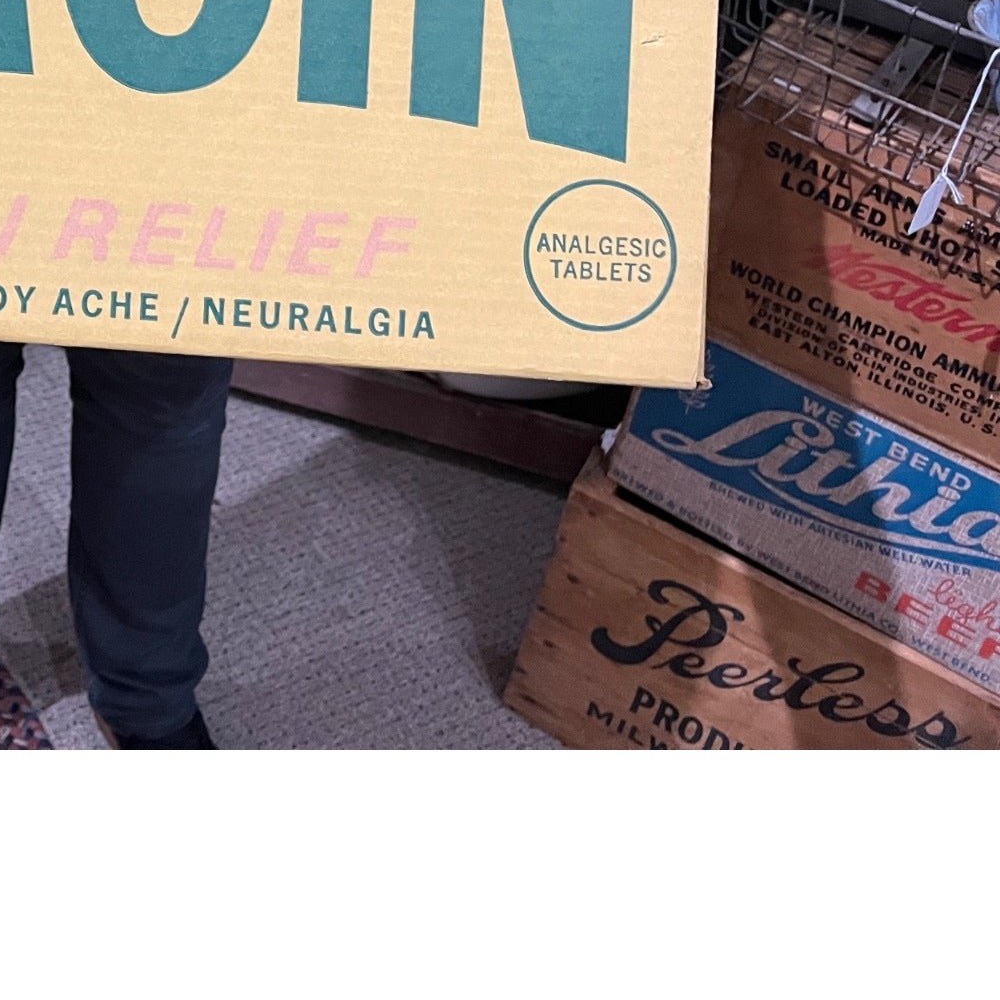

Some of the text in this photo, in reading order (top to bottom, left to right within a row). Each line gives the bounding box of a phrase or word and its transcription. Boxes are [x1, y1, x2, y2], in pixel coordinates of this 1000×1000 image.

[764, 141, 852, 190] SMALL
[780, 171, 887, 227] LOADED
[50, 195, 418, 279] RELIEF
[536, 232, 667, 260] ANALGESIC
[860, 225, 911, 257] MADE
[920, 250, 940, 267] IN
[549, 258, 653, 284] TABLETS
[51, 287, 160, 322] ACHE
[202, 295, 437, 340] NEURALGIA
[730, 259, 803, 303] WORLD
[807, 296, 928, 360] CHAMPION
[744, 288, 828, 335] WESTERN
[838, 332, 938, 384] CARTRIDGE
[748, 315, 793, 343] EAST
[757, 308, 822, 343] DIVISION
[827, 340, 848, 354] OF
[852, 351, 887, 374] OLIN
[801, 395, 973, 493] WEST BEND
[651, 409, 1000, 558] Lithia
[768, 505, 804, 527] WITH
[807, 522, 874, 552] ARTESIAN
[919, 557, 972, 577] WATER
[590, 579, 972, 750] Peerless
[911, 634, 950, 661] WEST
[950, 656, 991, 681] BEND
